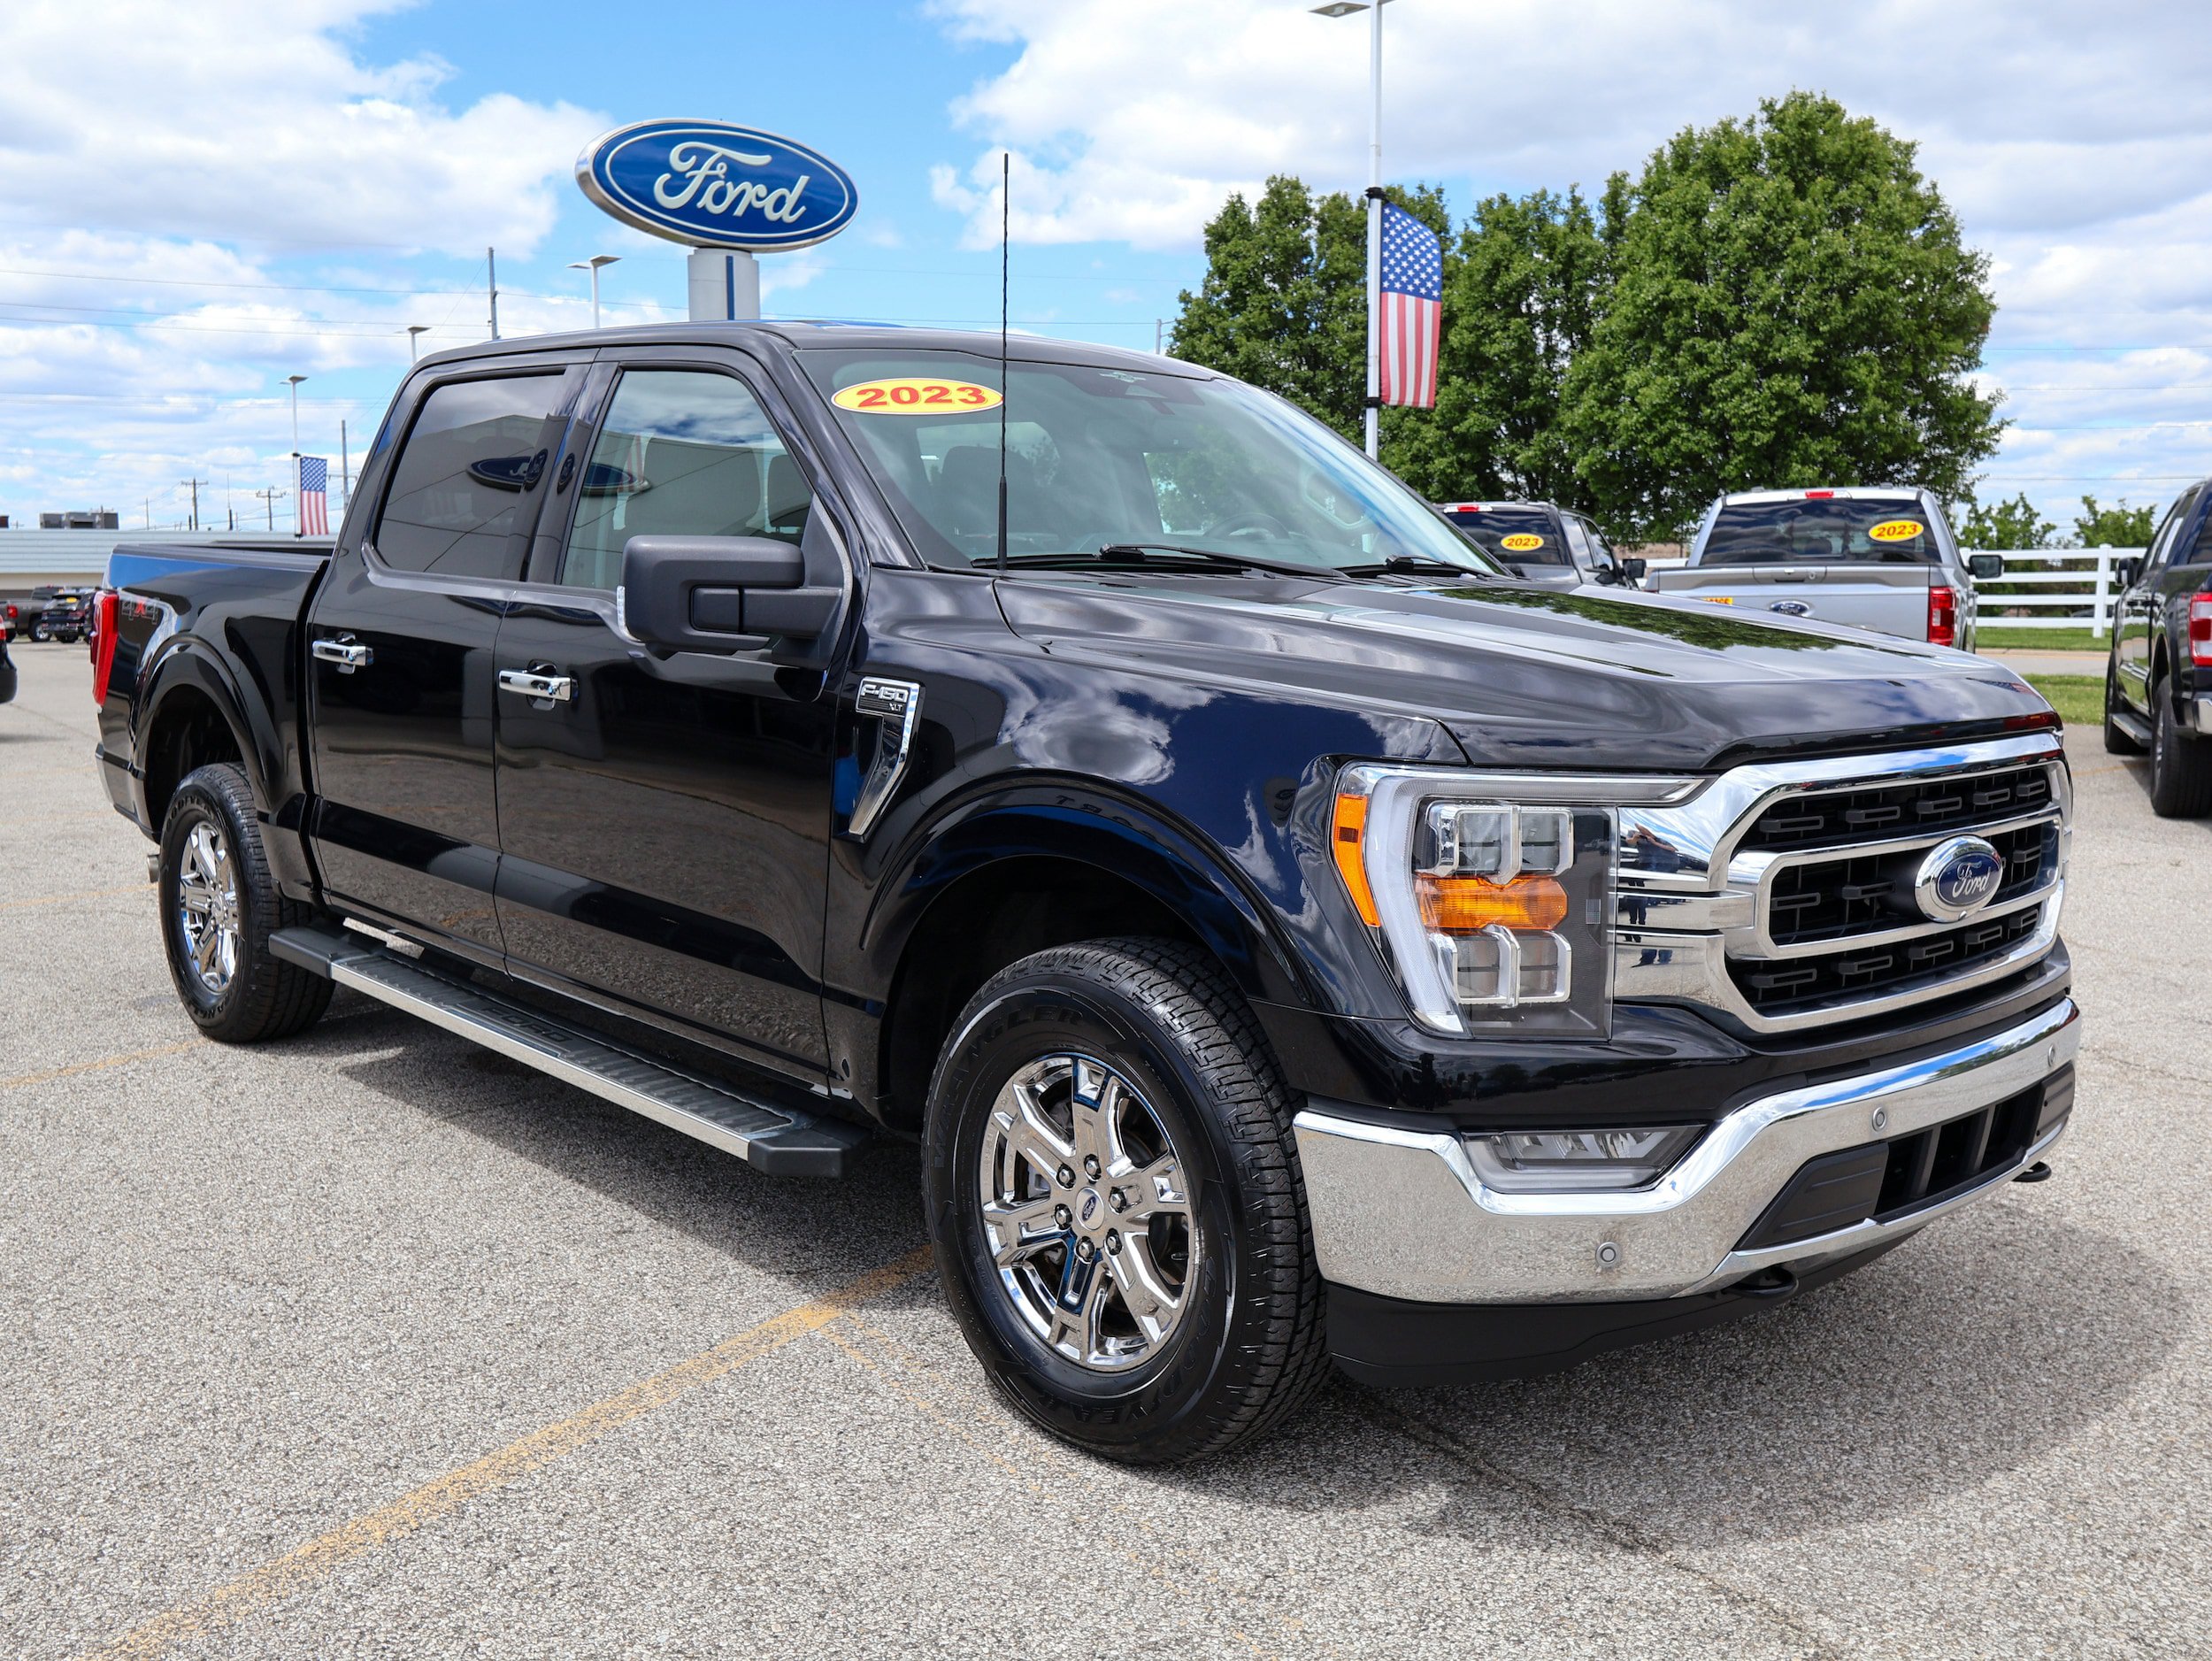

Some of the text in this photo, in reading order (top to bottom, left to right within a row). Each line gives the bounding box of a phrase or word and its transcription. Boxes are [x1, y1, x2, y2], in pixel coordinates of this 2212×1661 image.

[653, 141, 810, 224] Ford
[856, 386, 988, 408] 2023
[1876, 524, 1917, 537] 2023
[1507, 538, 1539, 547] 2023
[861, 684, 909, 703] F-150
[888, 703, 903, 711] XLT
[1952, 860, 1992, 898] Ford
